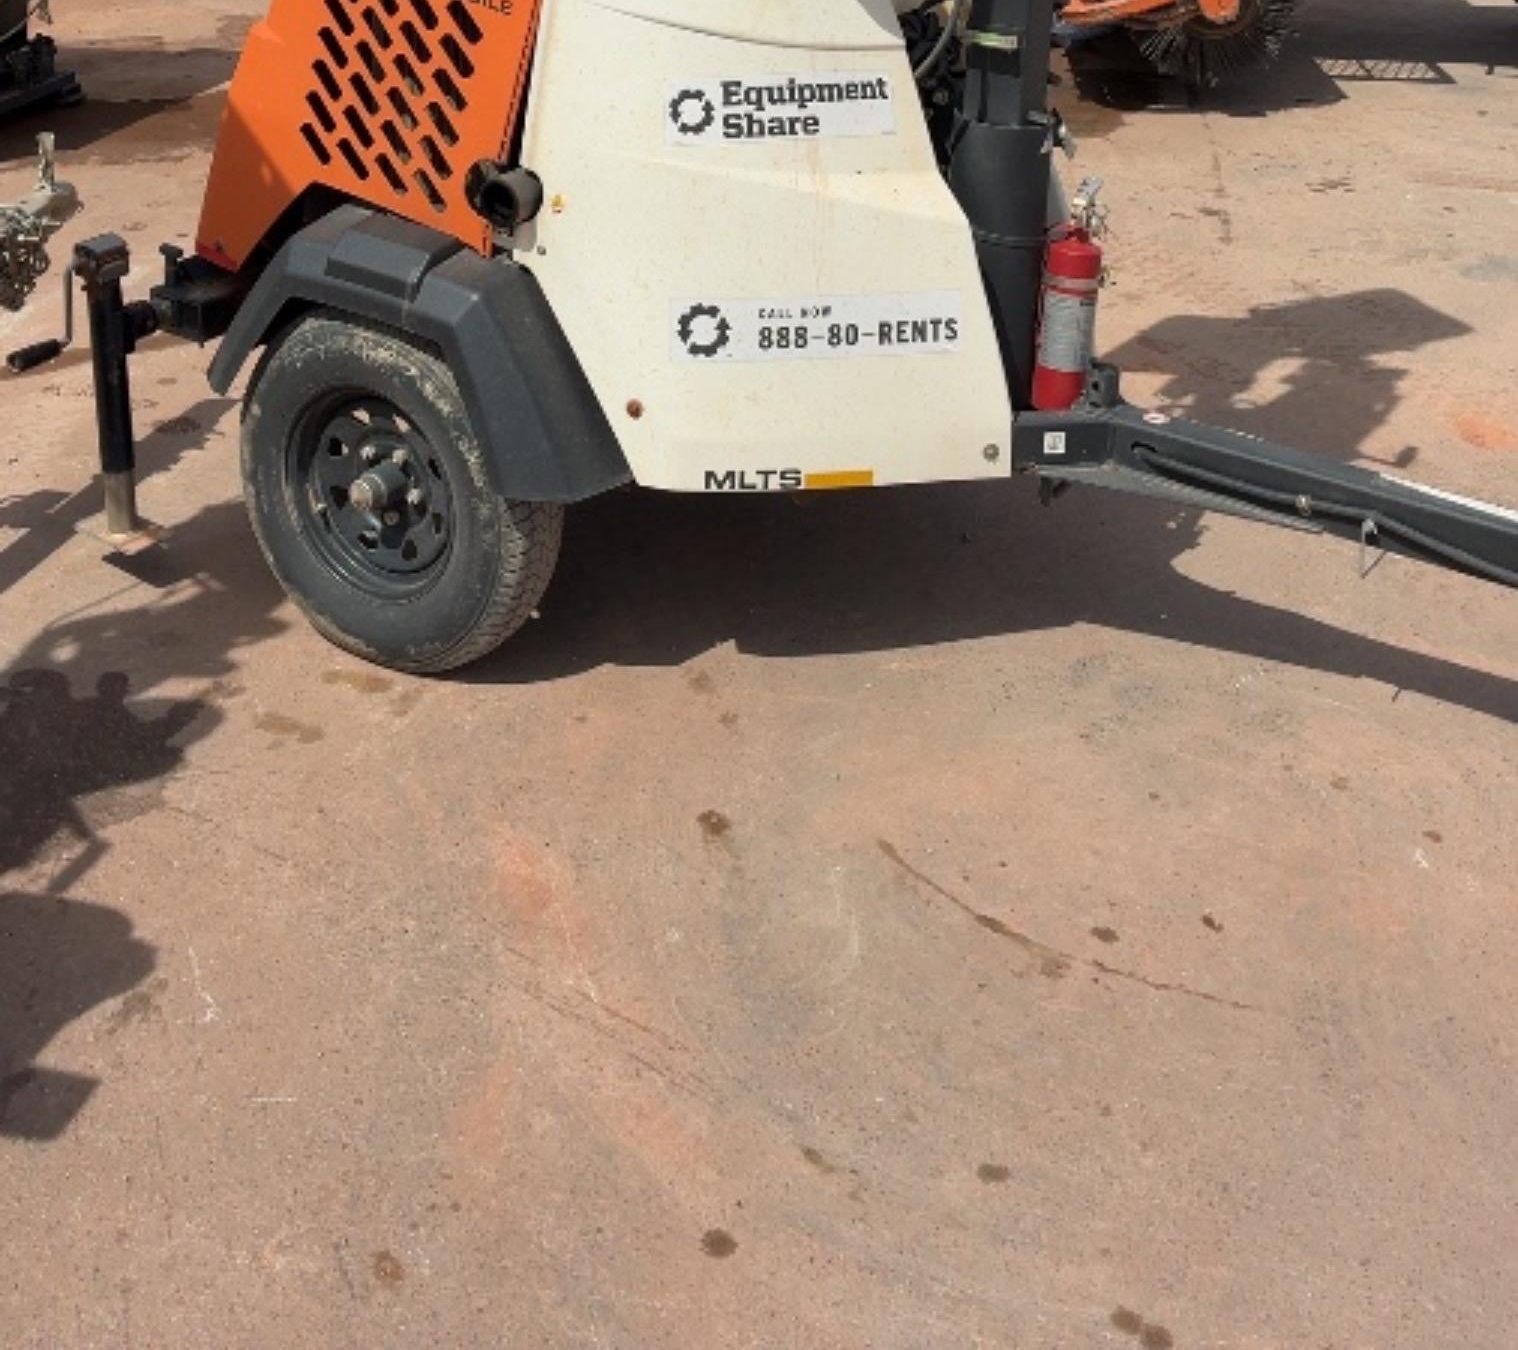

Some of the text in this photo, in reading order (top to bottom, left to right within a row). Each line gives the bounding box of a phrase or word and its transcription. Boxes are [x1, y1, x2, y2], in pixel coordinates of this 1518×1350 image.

[720, 77, 889, 111] Equipment
[722, 113, 820, 139] Share
[758, 305, 832, 319] CALL NOW
[758, 317, 959, 350] 888-80-RENTS
[704, 470, 802, 490] MLTS
